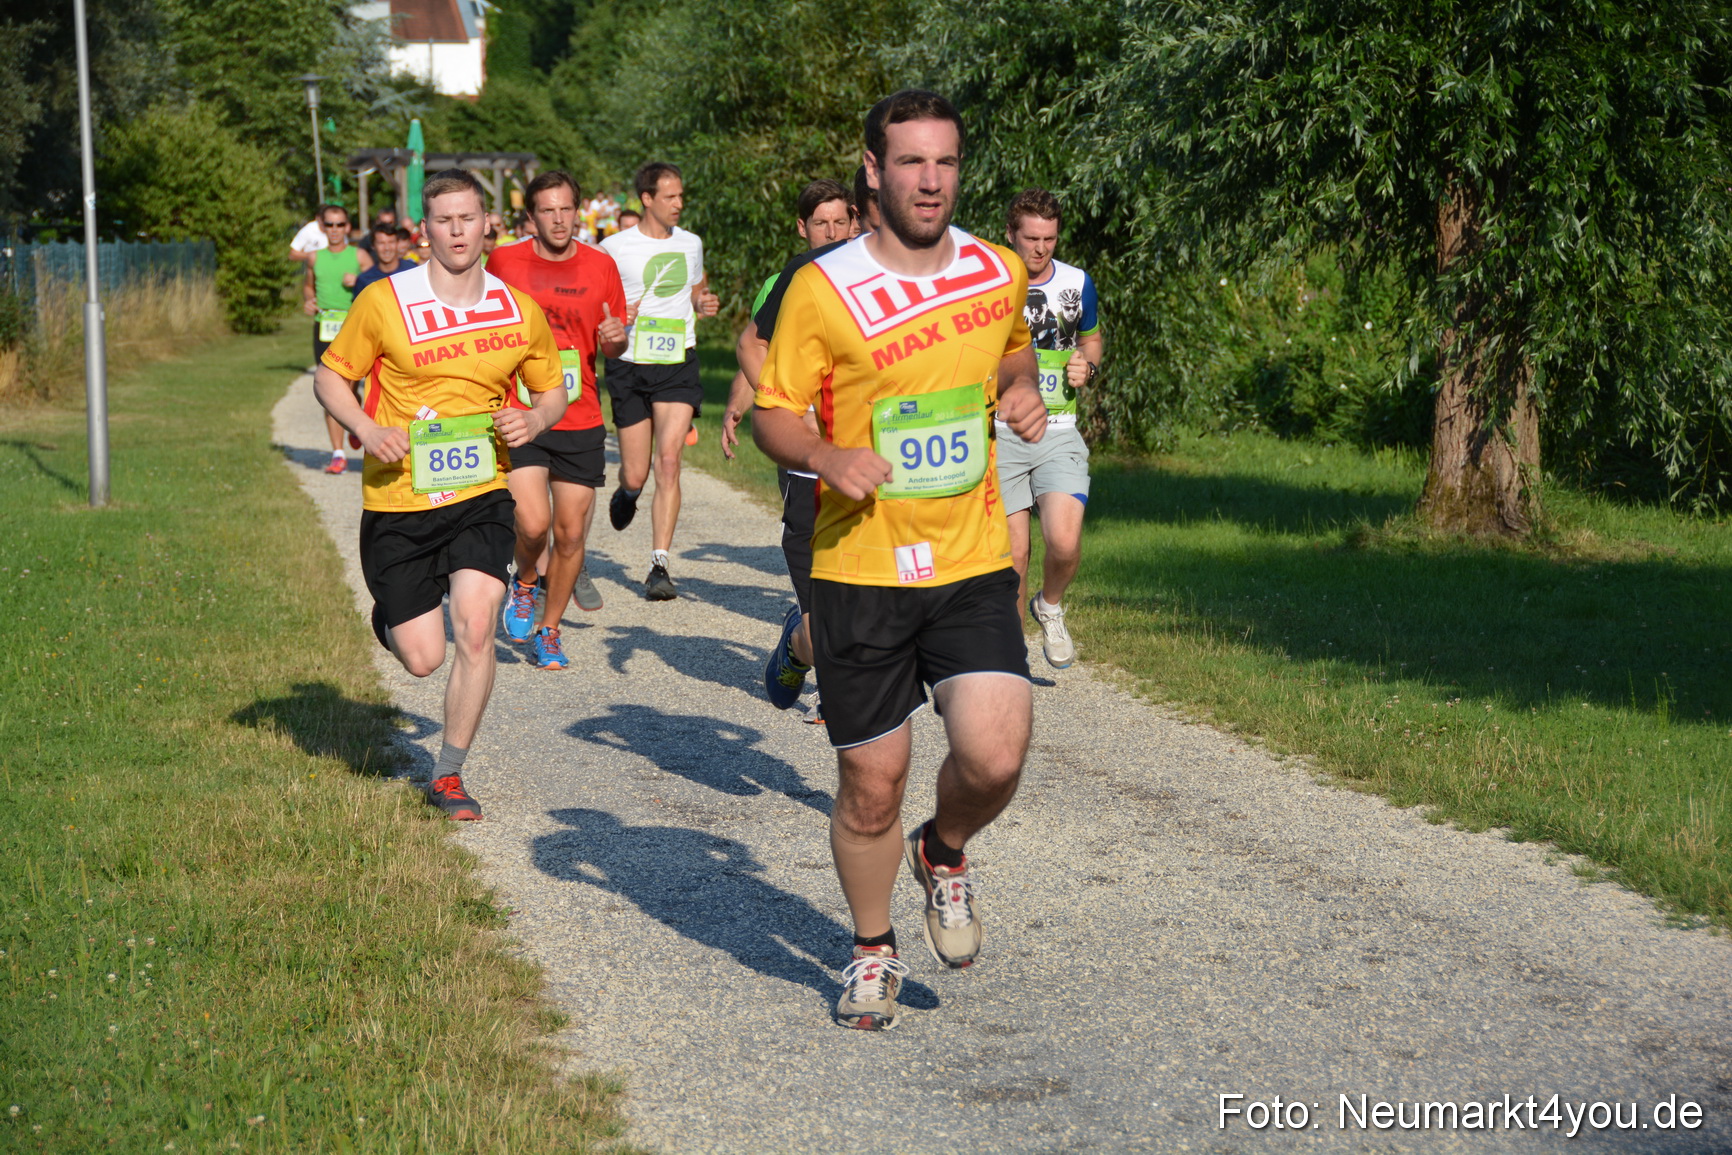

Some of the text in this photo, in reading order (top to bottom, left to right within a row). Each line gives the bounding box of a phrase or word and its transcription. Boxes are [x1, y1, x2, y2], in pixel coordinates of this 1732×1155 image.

[646, 336, 676, 352] 129
[870, 296, 1014, 372] MAX BÖGL
[413, 332, 528, 368] MAX BÖGL
[892, 410, 933, 422] firmenlauf
[429, 445, 480, 472] 865
[900, 430, 969, 470] 905
[908, 476, 938, 484] Andreas
[939, 471, 966, 481] Leopold
